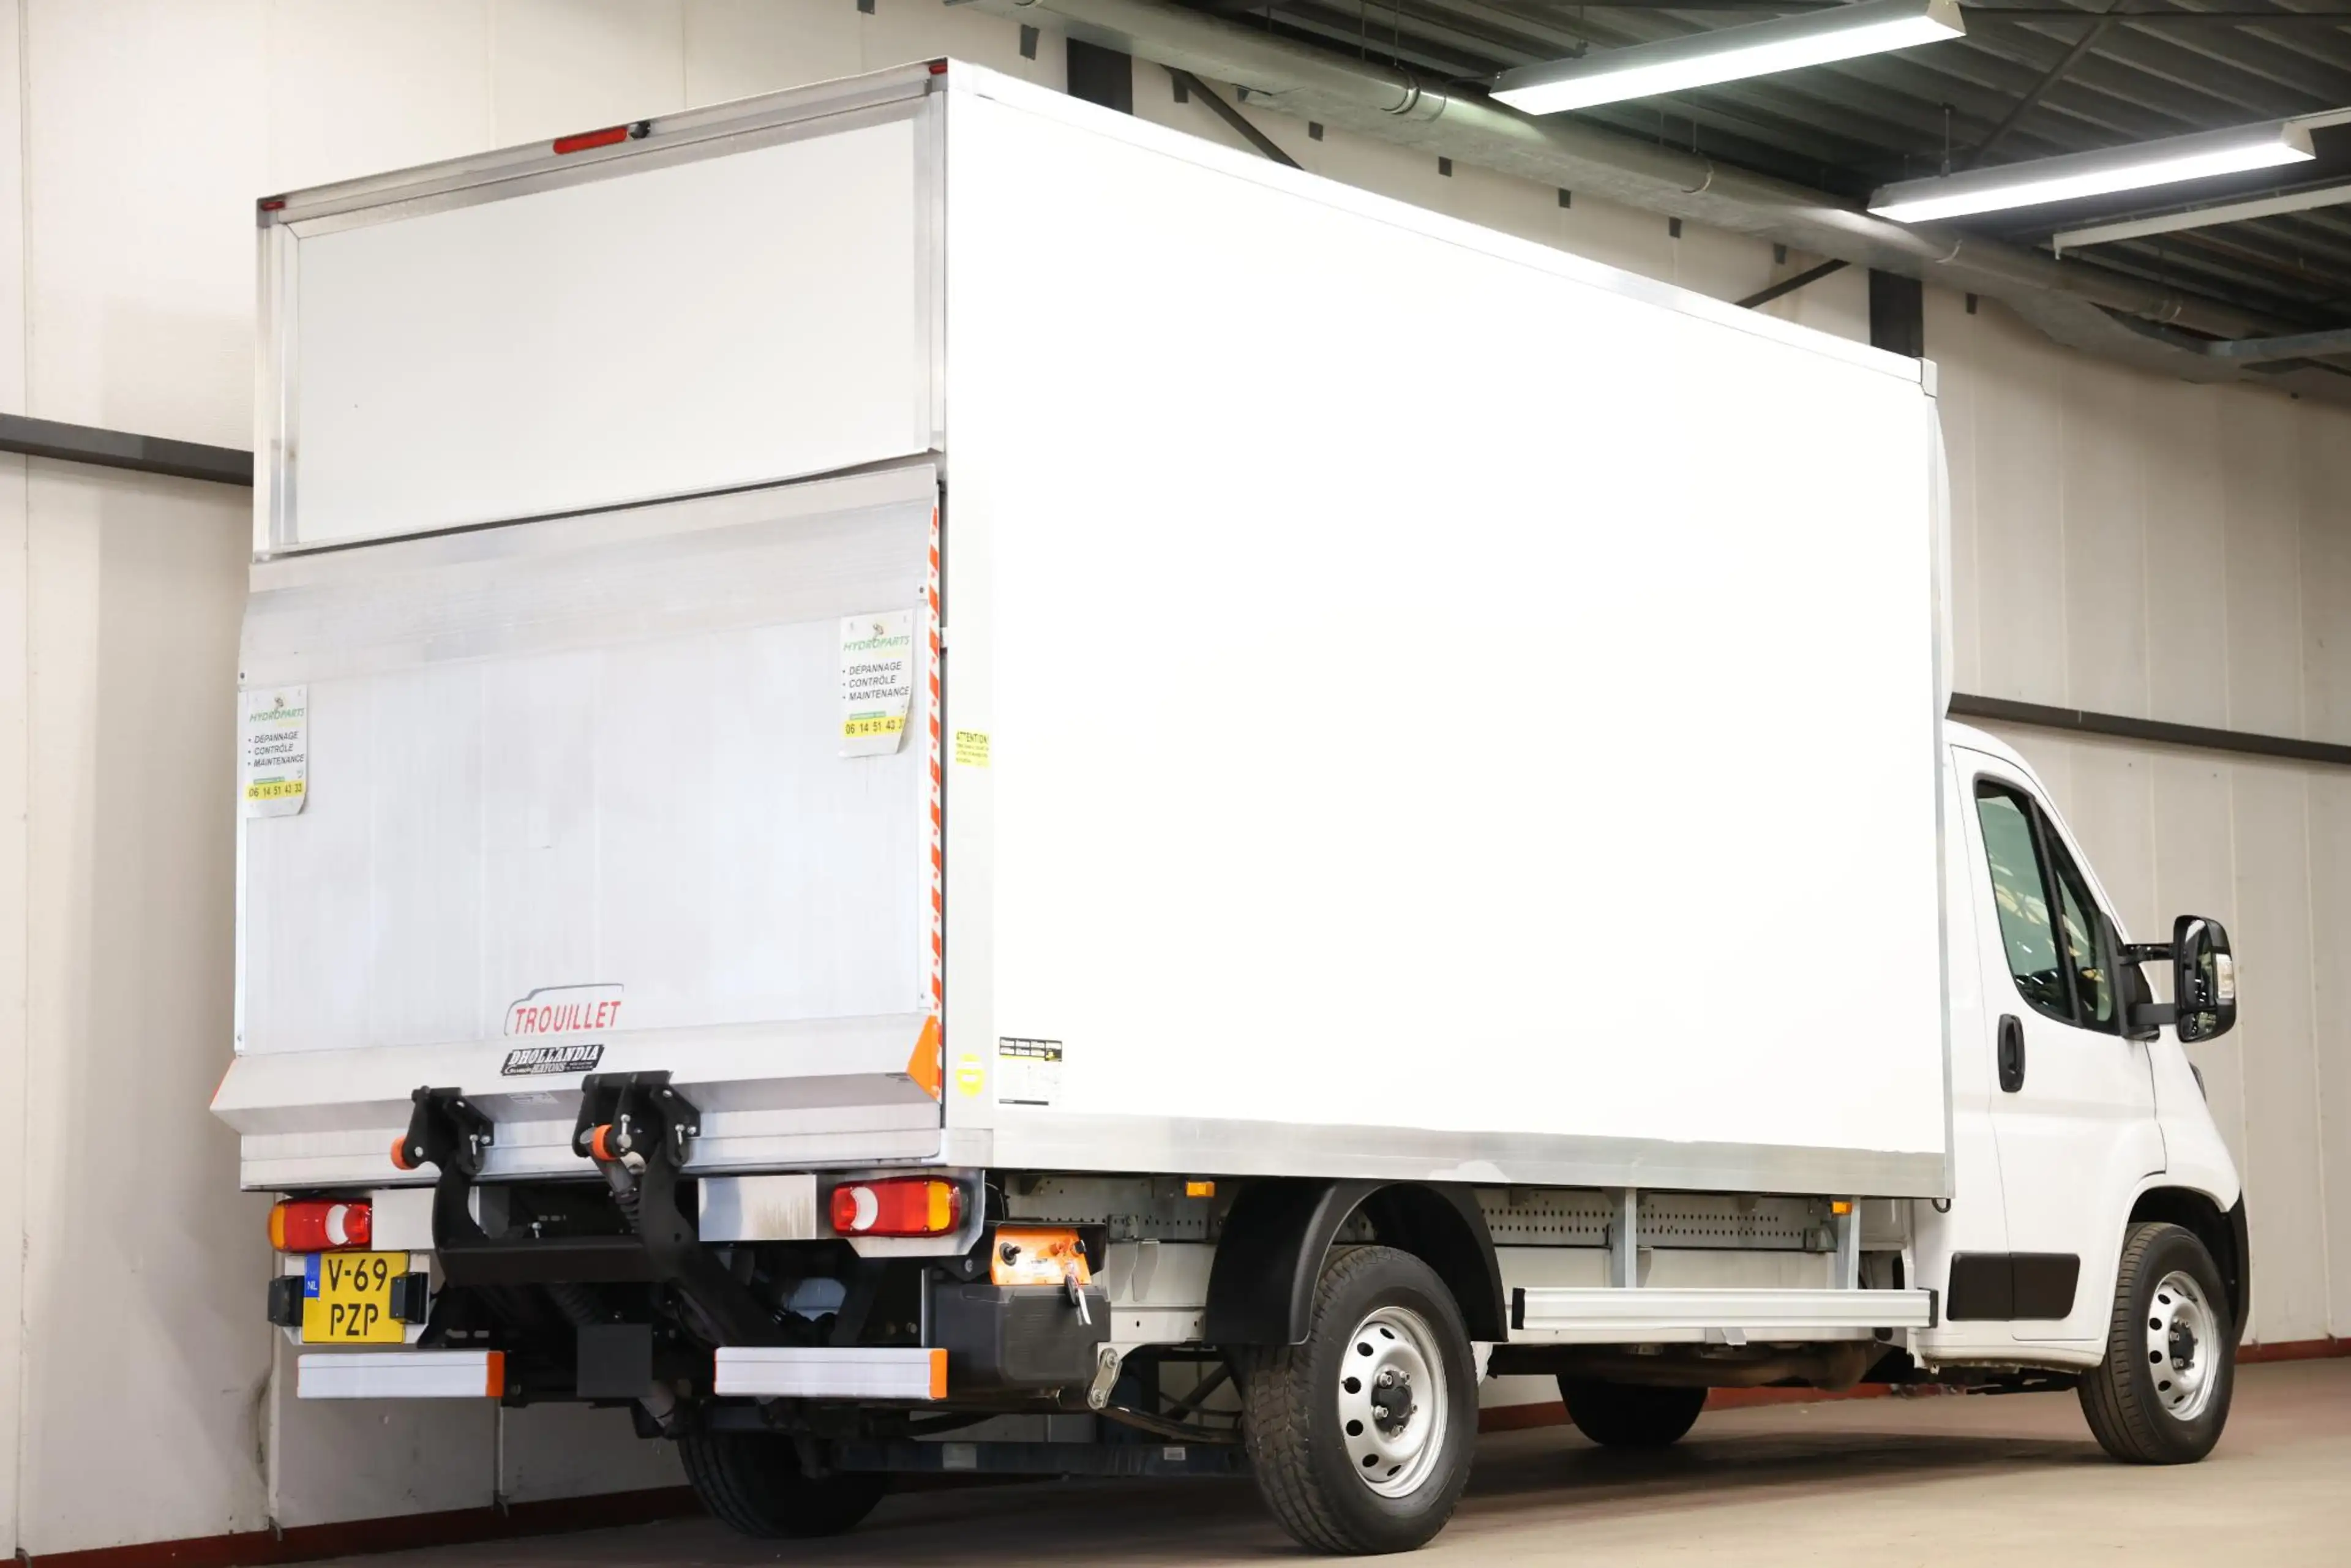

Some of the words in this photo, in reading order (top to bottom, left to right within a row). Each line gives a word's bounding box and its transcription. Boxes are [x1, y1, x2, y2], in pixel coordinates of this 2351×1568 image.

[843, 636, 910, 651] HYDROPARTS
[849, 661, 902, 675] DÉPANNAGE
[849, 675, 896, 688] CONTRÔLE
[849, 686, 909, 701] MAINTENANCE
[249, 708, 305, 722] HYDROPARTS
[845, 724, 855, 734] 06
[860, 723, 869, 733] 14
[872, 722, 882, 732] 51
[254, 743, 293, 756] CONTRÔLE
[253, 754, 304, 768] MAINTENANCE
[249, 787, 259, 797] 06
[515, 1001, 621, 1034] TROUILLET
[508, 1046, 599, 1065] DHOLLANDIA
[328, 1258, 388, 1292] V-69
[307, 1280, 318, 1291] NL
[330, 1304, 378, 1336] PZP
